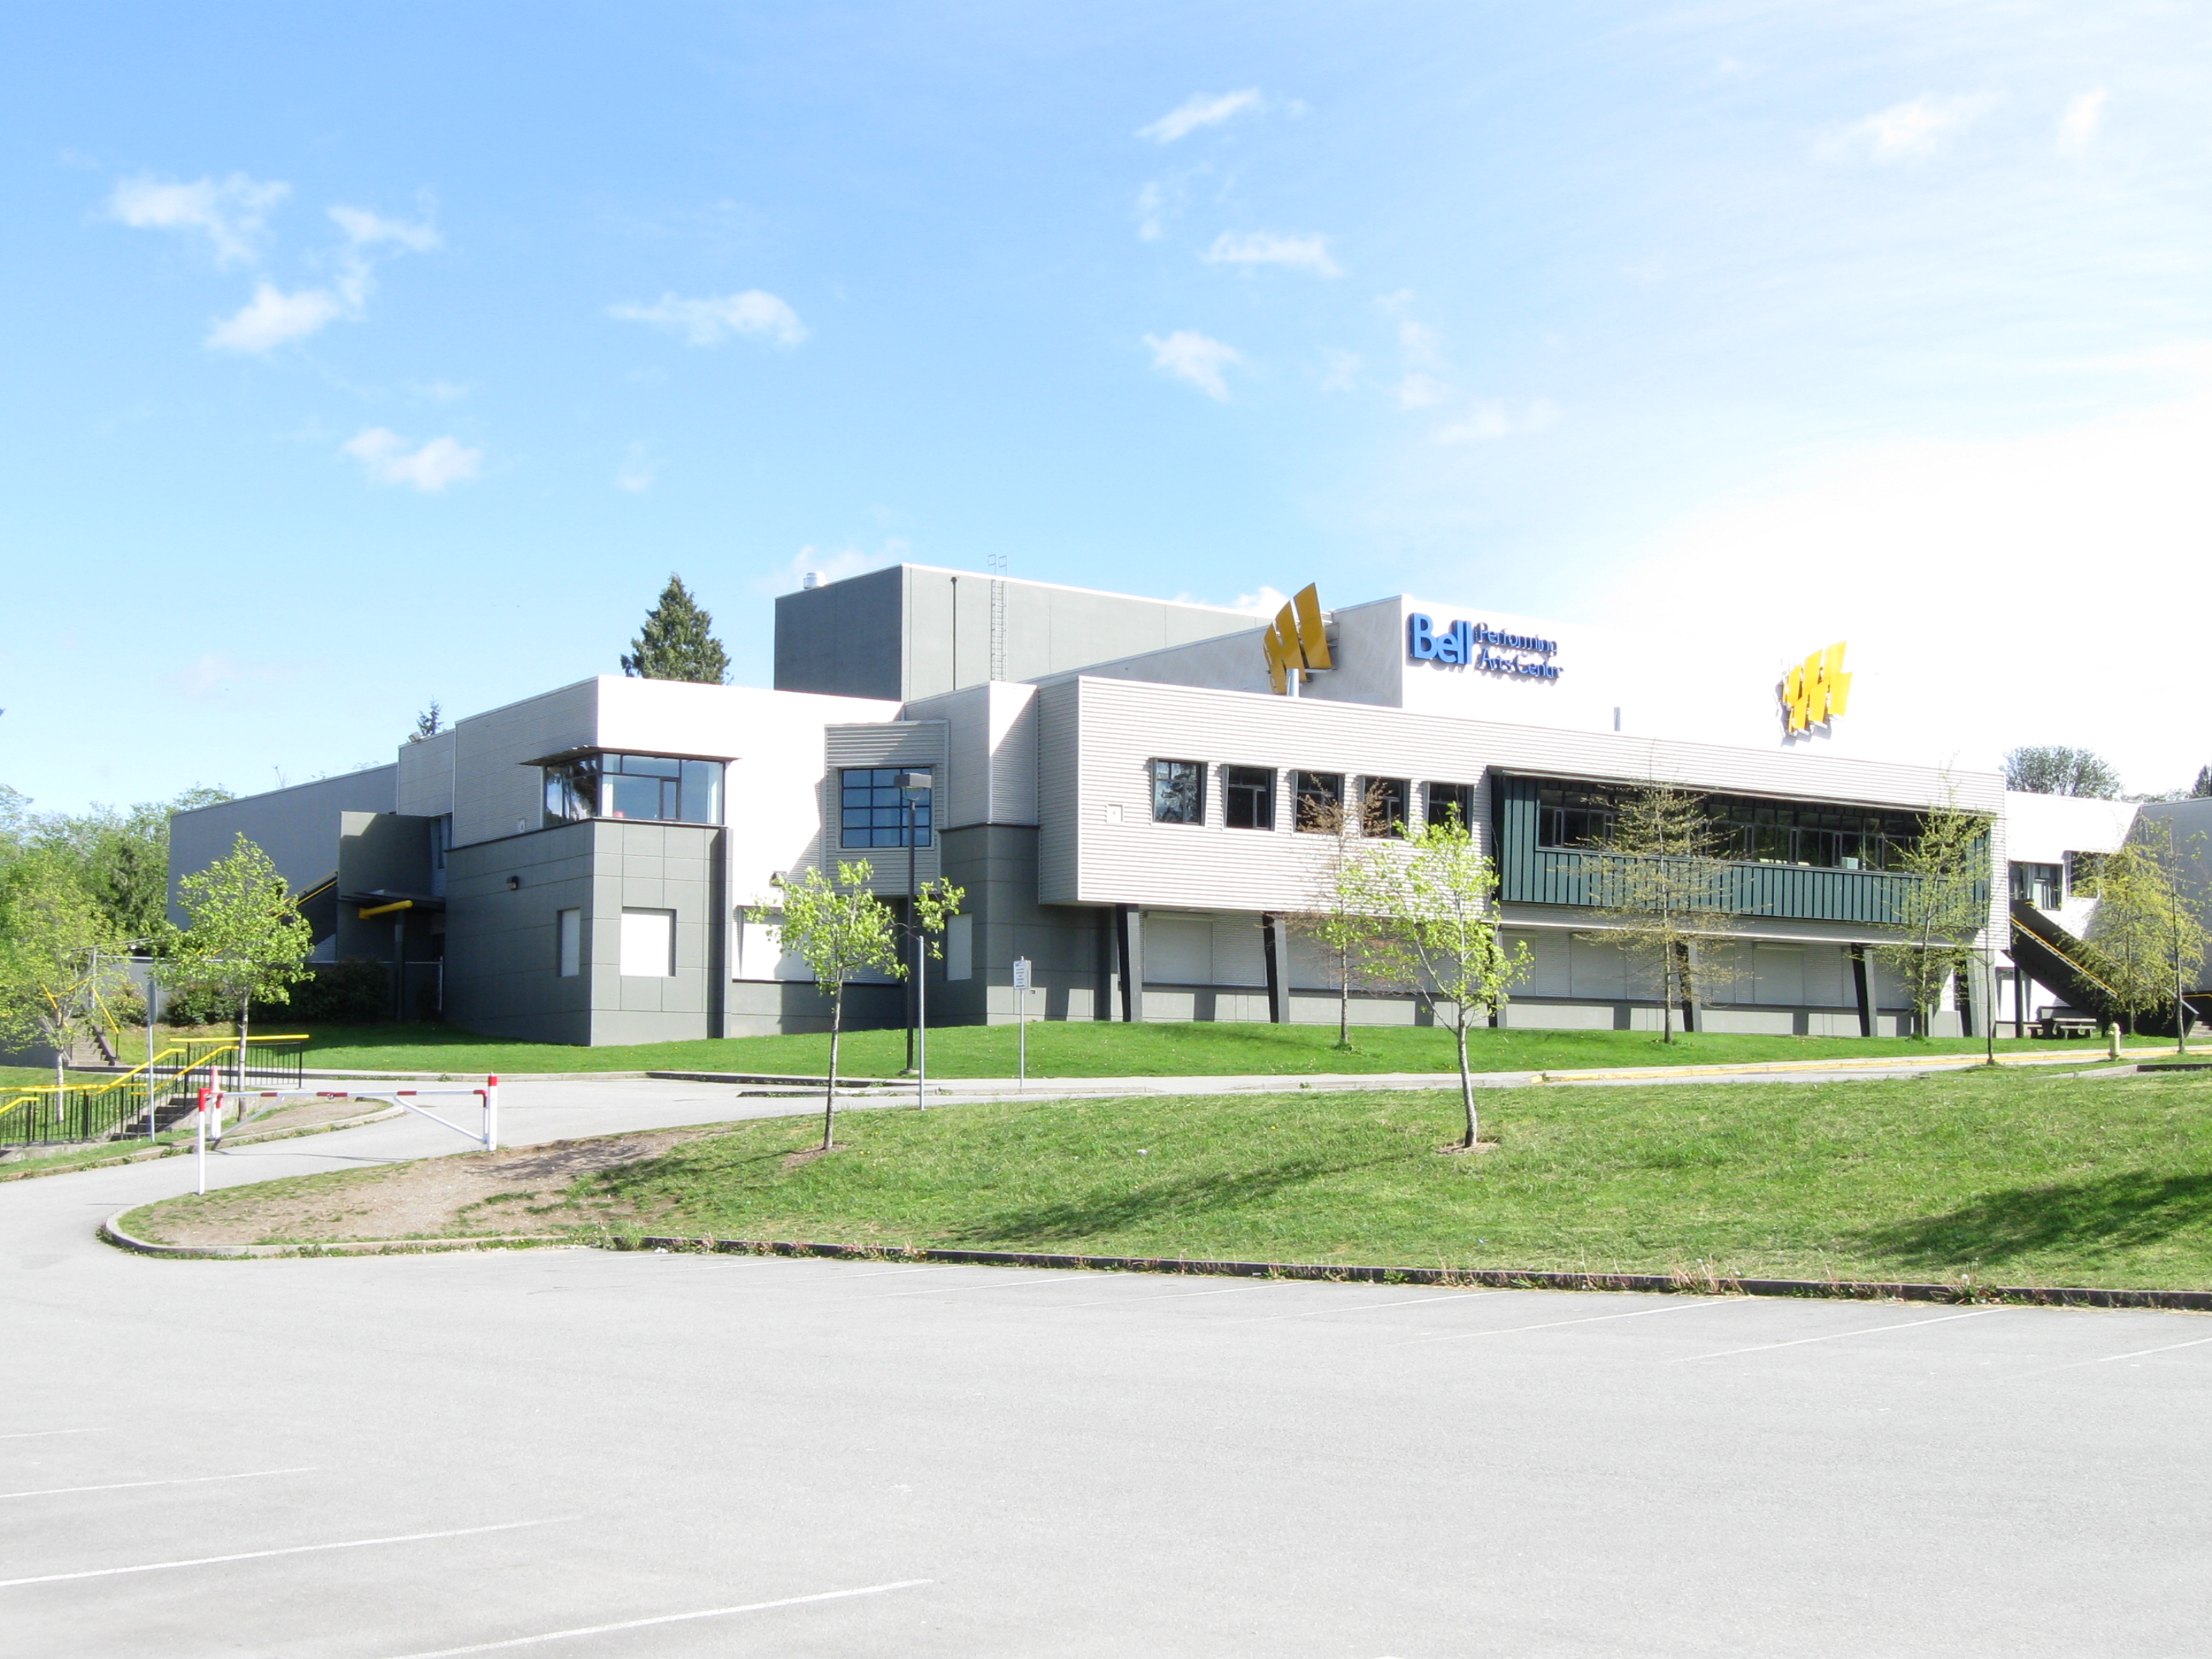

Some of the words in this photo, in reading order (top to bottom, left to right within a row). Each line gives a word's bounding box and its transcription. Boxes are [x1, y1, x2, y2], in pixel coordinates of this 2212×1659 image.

[1412, 612, 1472, 665] Bell
[1477, 622, 1557, 656] Performing
[1480, 648, 1513, 672] Arts
